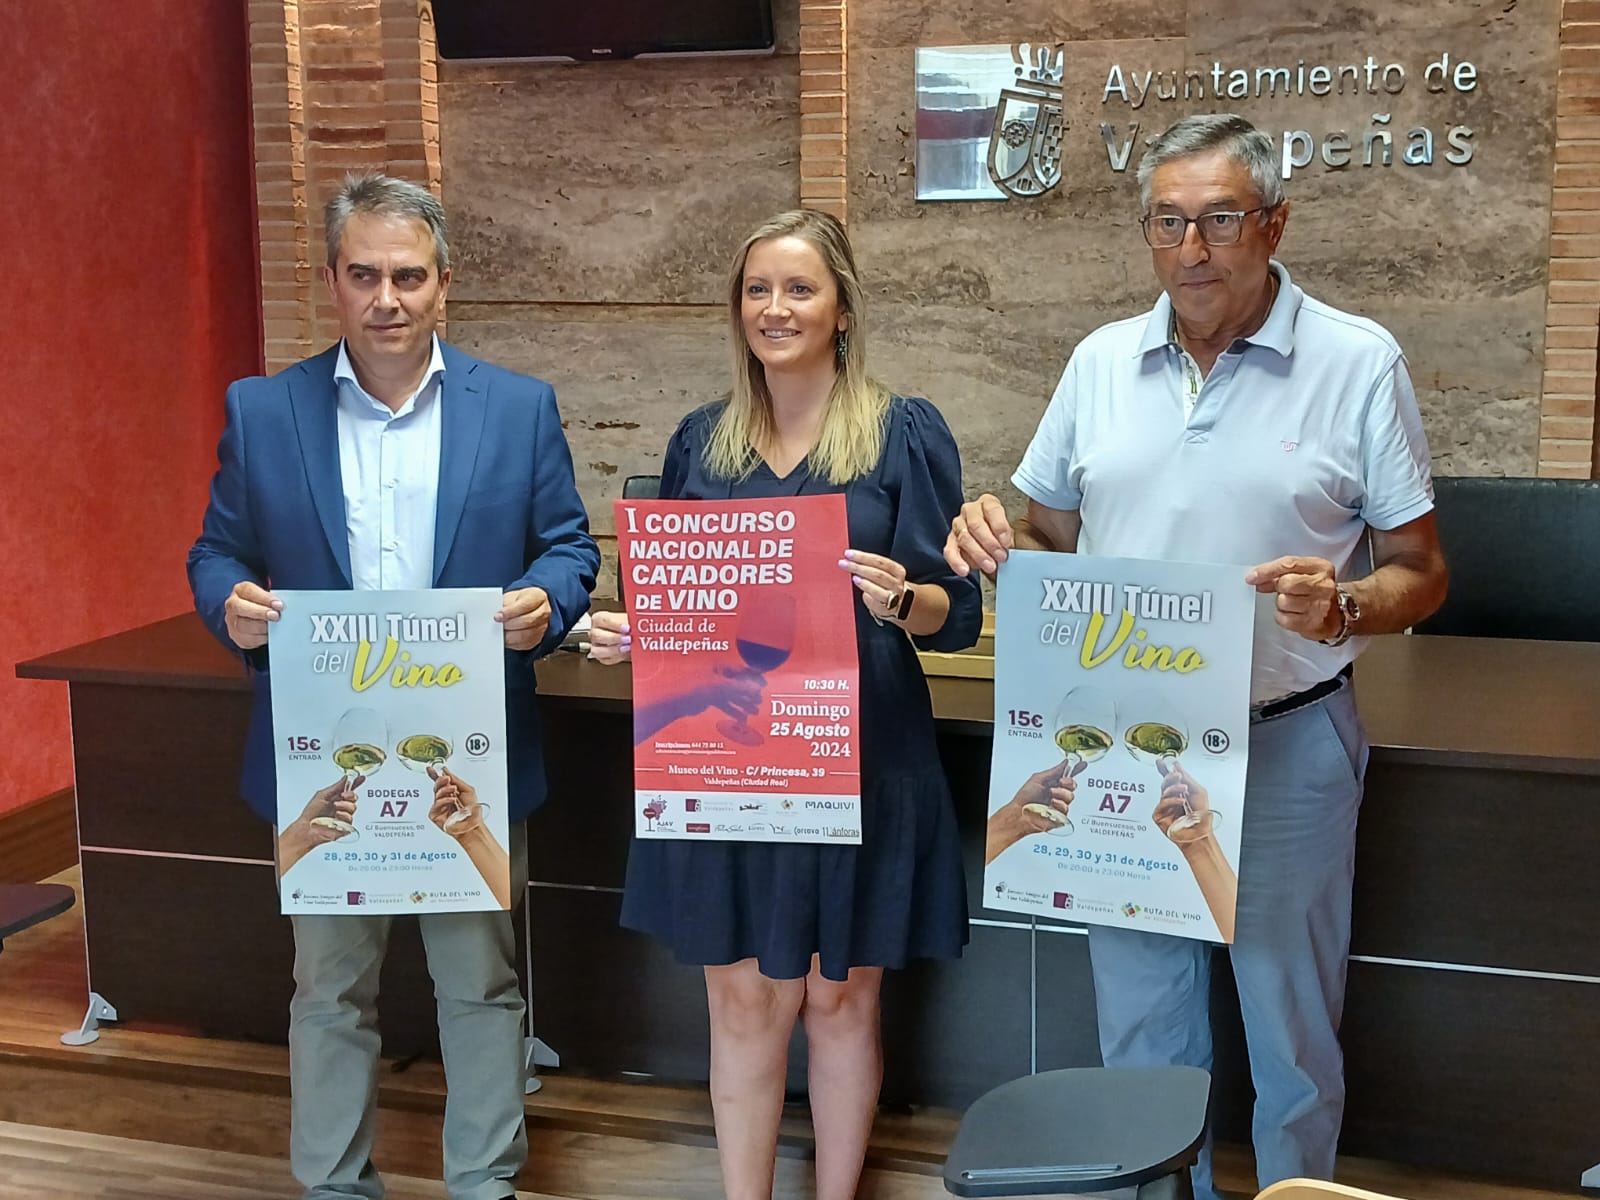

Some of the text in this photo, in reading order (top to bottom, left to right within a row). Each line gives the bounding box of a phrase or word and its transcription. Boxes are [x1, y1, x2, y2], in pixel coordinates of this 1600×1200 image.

[1102, 53, 1478, 109] Ayuntamiento de
[1100, 113, 1474, 180] Vpeñas
[624, 507, 796, 534] I CONCURSO
[629, 538, 794, 560] NACIONAL DE
[632, 563, 793, 585] CATADORES
[635, 589, 738, 610] DE VINO
[1040, 578, 1212, 624] XXIII Túnel
[310, 612, 466, 643] XXIII Túnel
[637, 618, 716, 633] Ciudad de
[639, 636, 729, 654] Valdepeñas
[1040, 610, 1209, 674] del Vino
[313, 634, 466, 692] del Vino
[804, 680, 850, 690] 10:30 H.
[771, 700, 850, 721] Domingo
[1008, 709, 1043, 728] 15€
[770, 722, 850, 739] 25 Agosto
[1008, 729, 1043, 739] ENTRADA
[288, 736, 321, 751] 15€
[470, 739, 486, 751] 18+
[810, 741, 851, 757] 2024
[1208, 734, 1226, 747] 18+
[668, 764, 698, 774] Museo
[700, 765, 714, 774] del
[716, 765, 738, 775] Vino
[746, 766, 760, 776] C/
[760, 766, 810, 777] Princesa,
[812, 768, 825, 777] 39
[704, 777, 789, 788] Valdepeñas (Ciudad Real)
[1087, 778, 1145, 793] BODEGAS
[367, 789, 420, 798] BODEGAS
[380, 800, 408, 818] A7
[805, 801, 855, 810] MAQUIVI
[1099, 793, 1131, 814] A7
[1090, 827, 1135, 839] VALDEPEÑAS
[324, 851, 457, 863] 28, 29, 30 y 31 de Agosto
[1033, 844, 1179, 871] 28, 29, 30 y 31 de Agosto
[1143, 907, 1201, 921] RUTA DEL VINO
